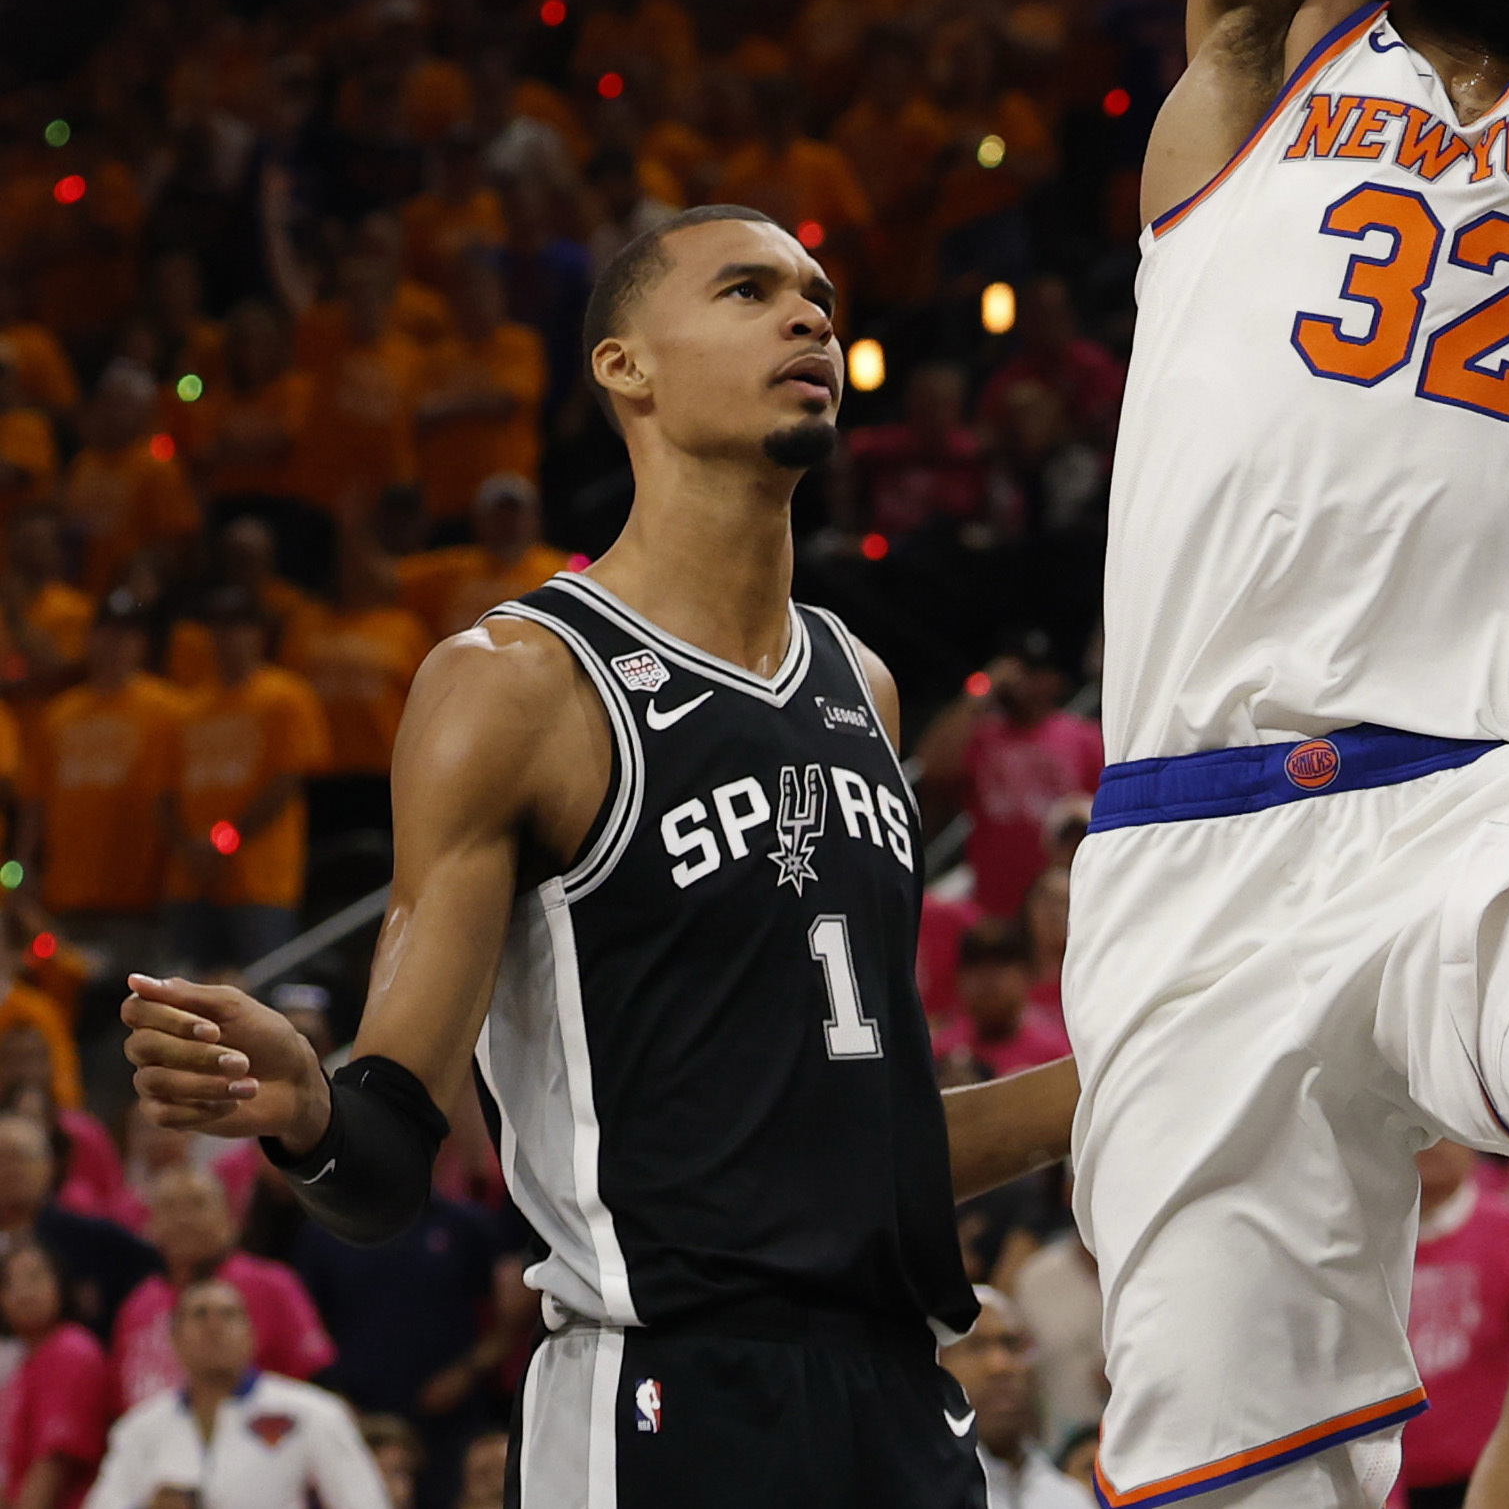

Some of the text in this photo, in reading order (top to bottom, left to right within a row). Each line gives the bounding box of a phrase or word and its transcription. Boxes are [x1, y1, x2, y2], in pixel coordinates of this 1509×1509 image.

[1280, 93, 1472, 183] NEW
[618, 656, 654, 671] USA
[1291, 750, 1334, 776] KNICKS
[660, 762, 915, 890] SPURS
[807, 913, 884, 1062] 1
